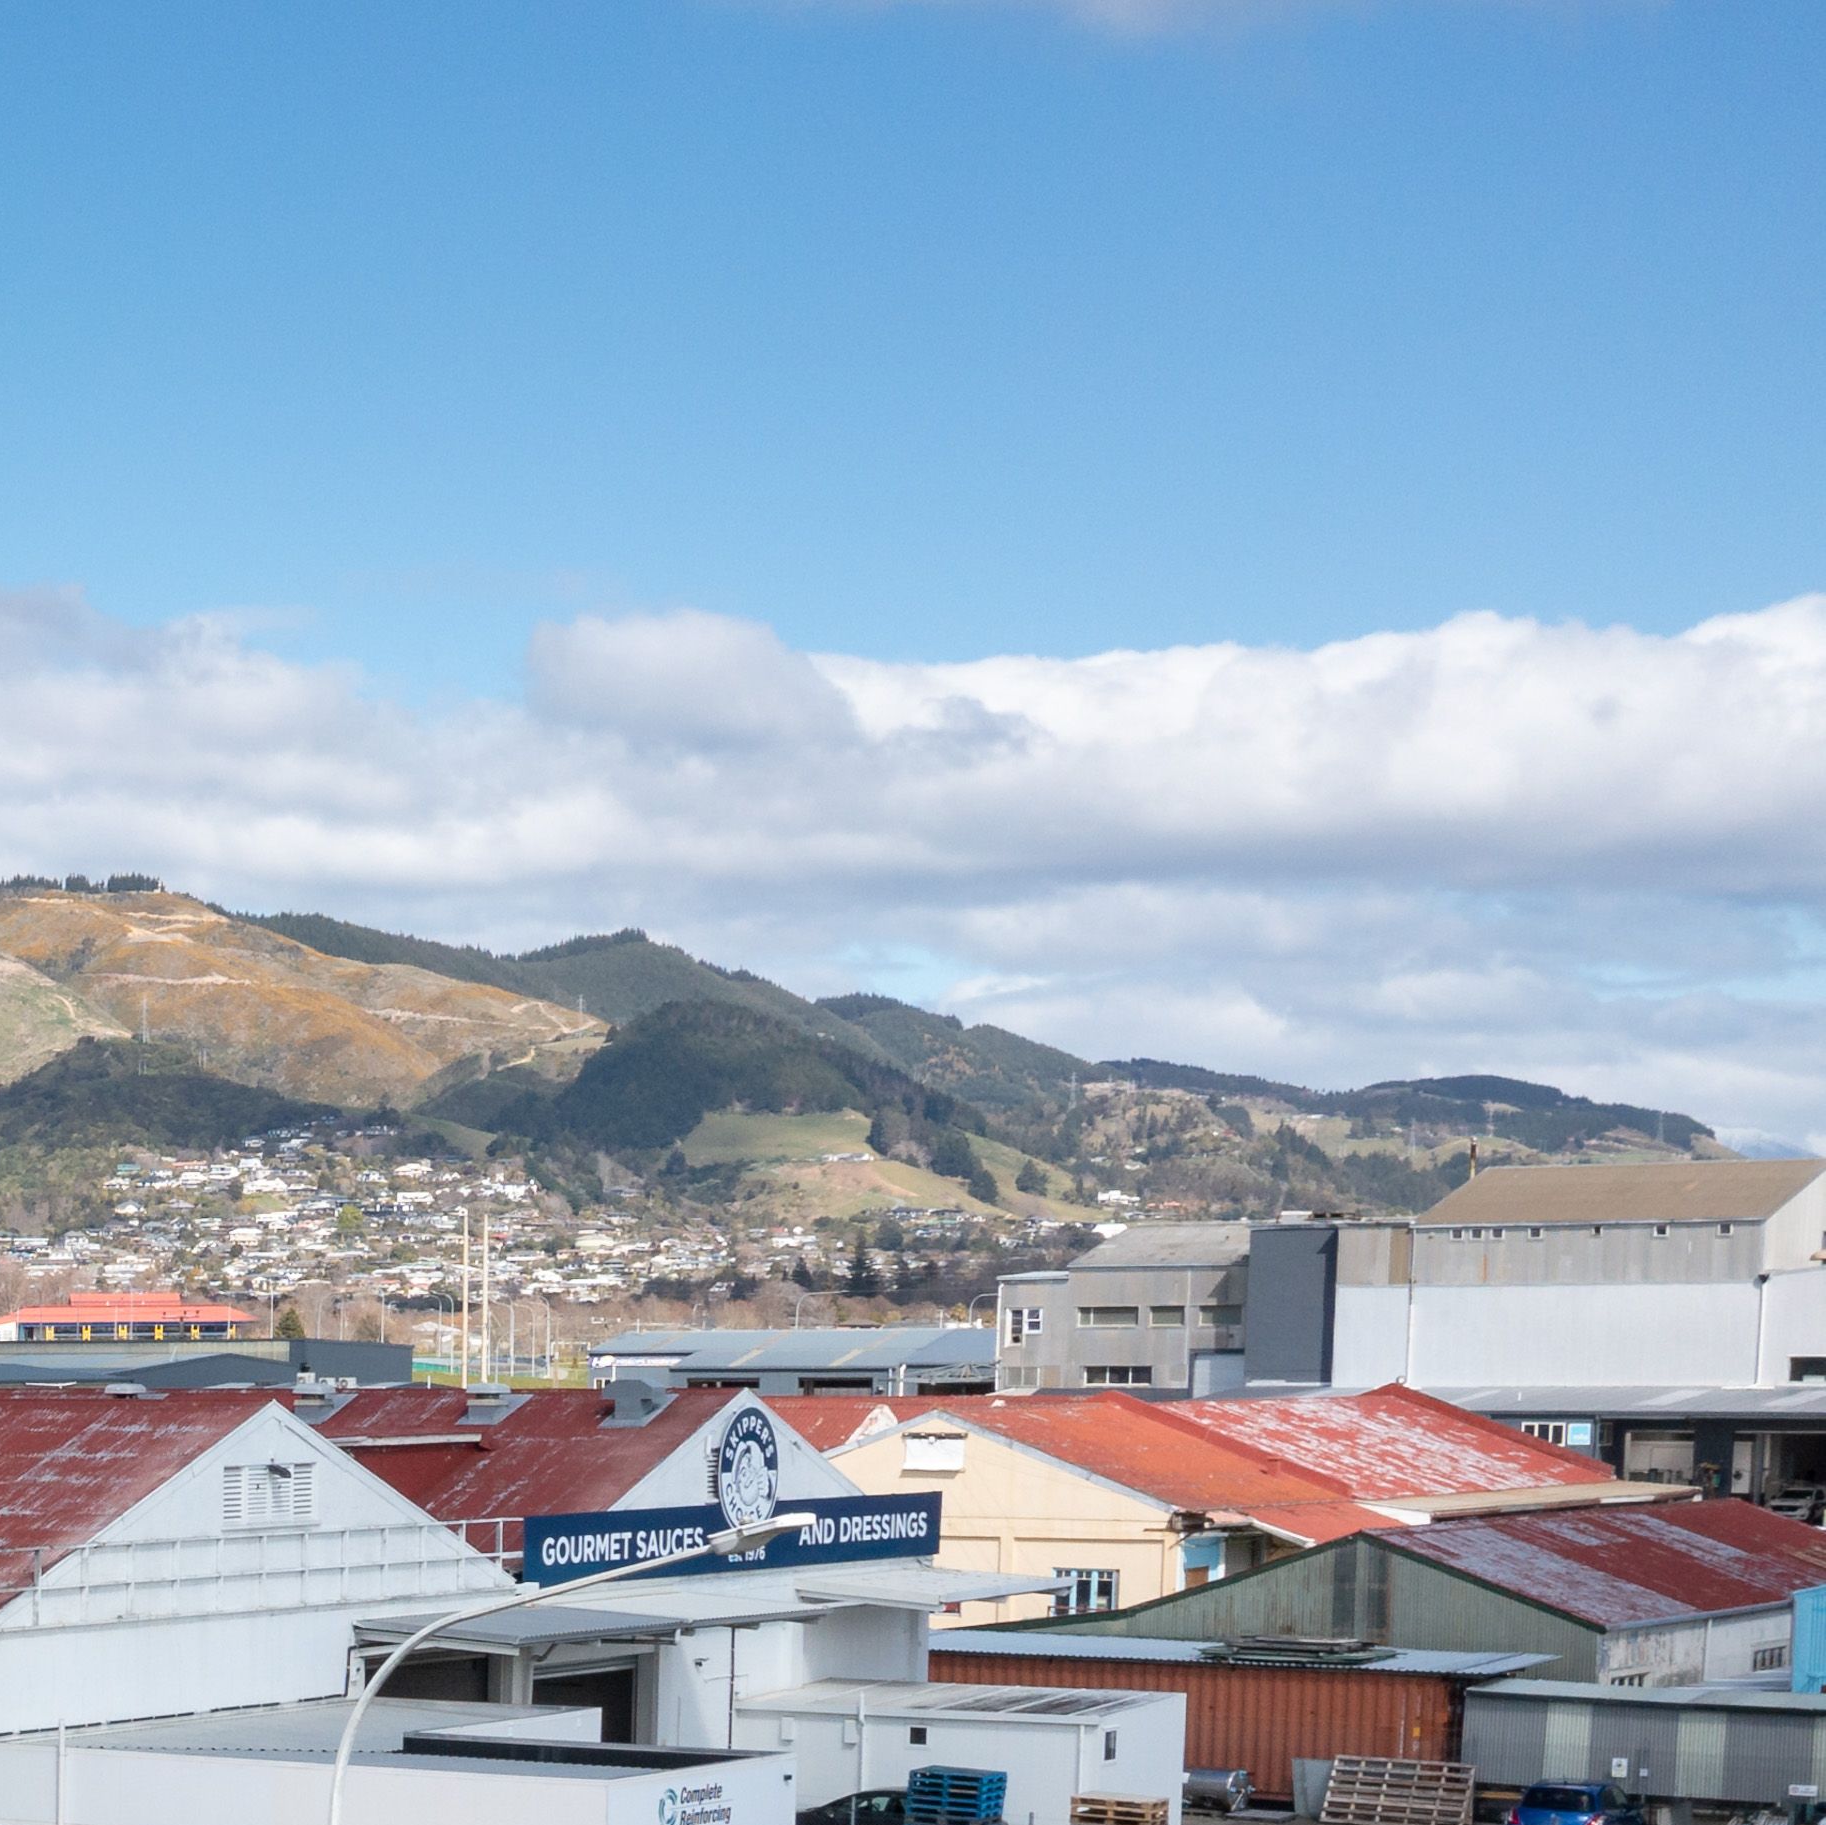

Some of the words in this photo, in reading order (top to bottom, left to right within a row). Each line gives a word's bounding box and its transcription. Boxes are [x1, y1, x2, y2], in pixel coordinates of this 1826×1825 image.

[725, 1415, 775, 1461] SKIPPER'S
[725, 1483, 763, 1521] CHOCE
[542, 1532, 632, 1566] GOURMET
[636, 1527, 704, 1559] SAUCES
[799, 1518, 835, 1546] AND
[840, 1512, 928, 1542] DRESSINGS
[680, 1783, 723, 1805] Complete
